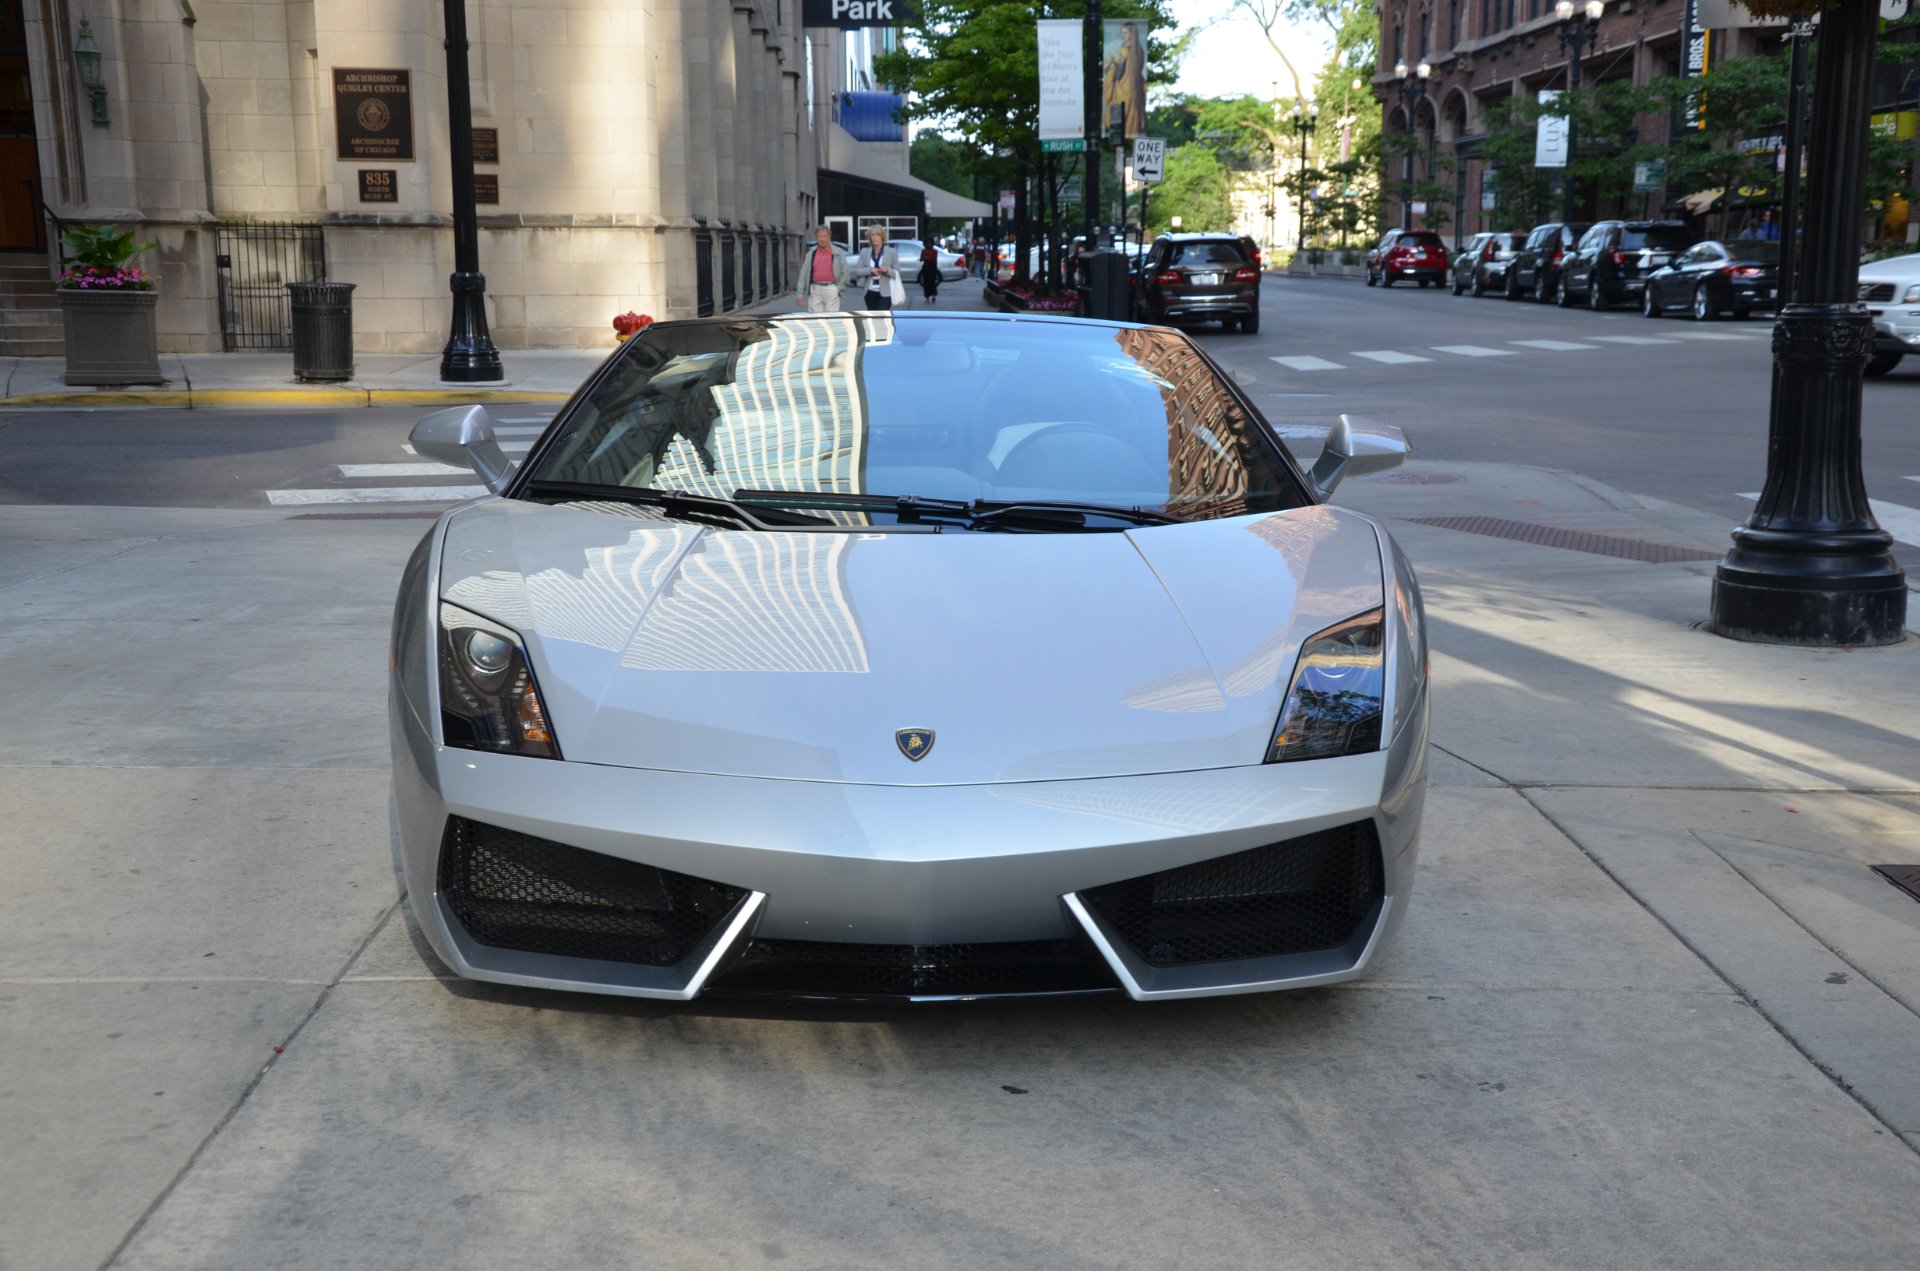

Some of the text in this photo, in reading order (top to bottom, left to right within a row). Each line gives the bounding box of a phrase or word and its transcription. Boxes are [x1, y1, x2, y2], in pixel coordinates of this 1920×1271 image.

[832, 0, 893, 19] Park
[1042, 38, 1060, 46] Take
[1057, 50, 1075, 58] Year
[1052, 63, 1078, 72] Mercy
[345, 74, 398, 82] ARCHBISHOP
[337, 84, 407, 93] QUIGLEY CENTER
[1050, 141, 1073, 150] RUSH
[1138, 141, 1161, 153] ONE
[1137, 153, 1160, 165] WAY
[366, 172, 390, 185] 835
